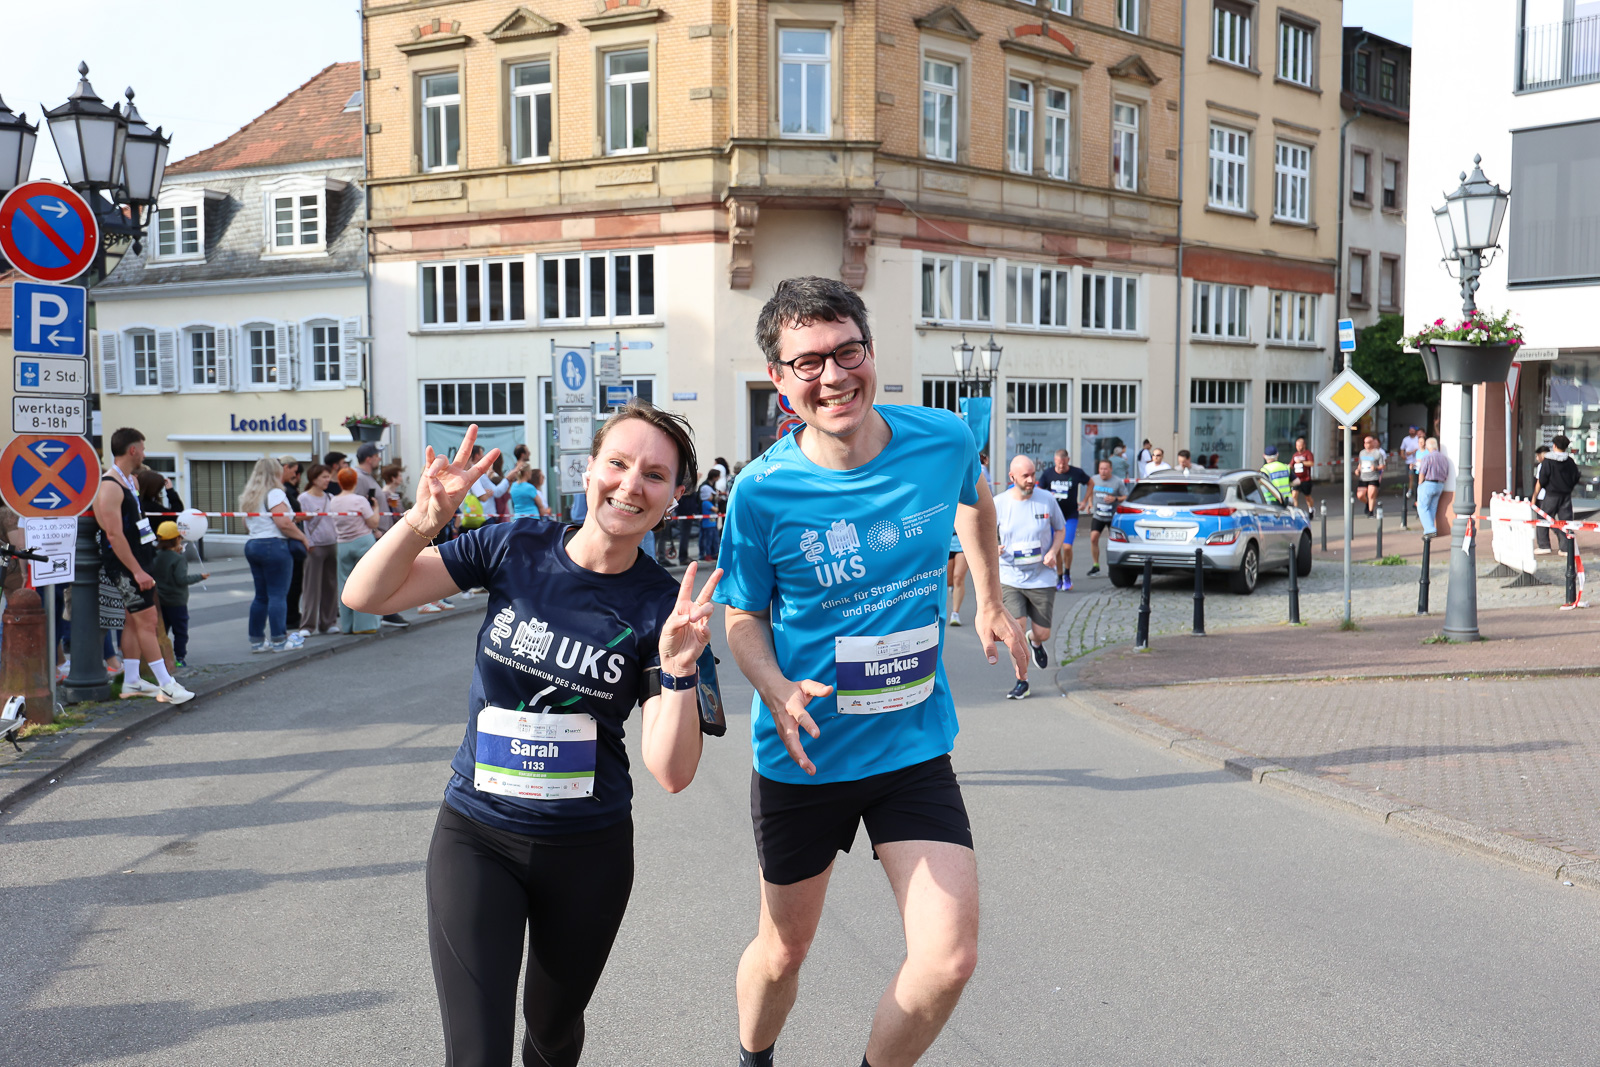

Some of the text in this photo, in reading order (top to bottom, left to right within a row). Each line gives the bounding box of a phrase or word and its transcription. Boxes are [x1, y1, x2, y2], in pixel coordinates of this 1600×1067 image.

[31, 292, 69, 345] P
[1514, 350, 1554, 359] losterstraße
[43, 370, 80, 383] 2 Std.
[565, 393, 585, 404] ZONE
[19, 403, 80, 417] werktags
[230, 412, 307, 432] Leonidas
[1015, 439, 1042, 454] mehr
[904, 526, 924, 539] UTS
[815, 555, 866, 588] UKS
[821, 597, 851, 610] Klinik
[854, 591, 869, 602] für
[842, 583, 938, 618] und Radioonkologie
[483, 646, 554, 682] UNIVERSITÄTSKLINIKUM
[555, 636, 625, 684] UKS
[865, 656, 919, 677] Markus
[554, 676, 614, 700] DES SAARLANDES
[886, 676, 901, 686] 692
[510, 739, 559, 758] Sarah
[522, 761, 545, 770] 1133
